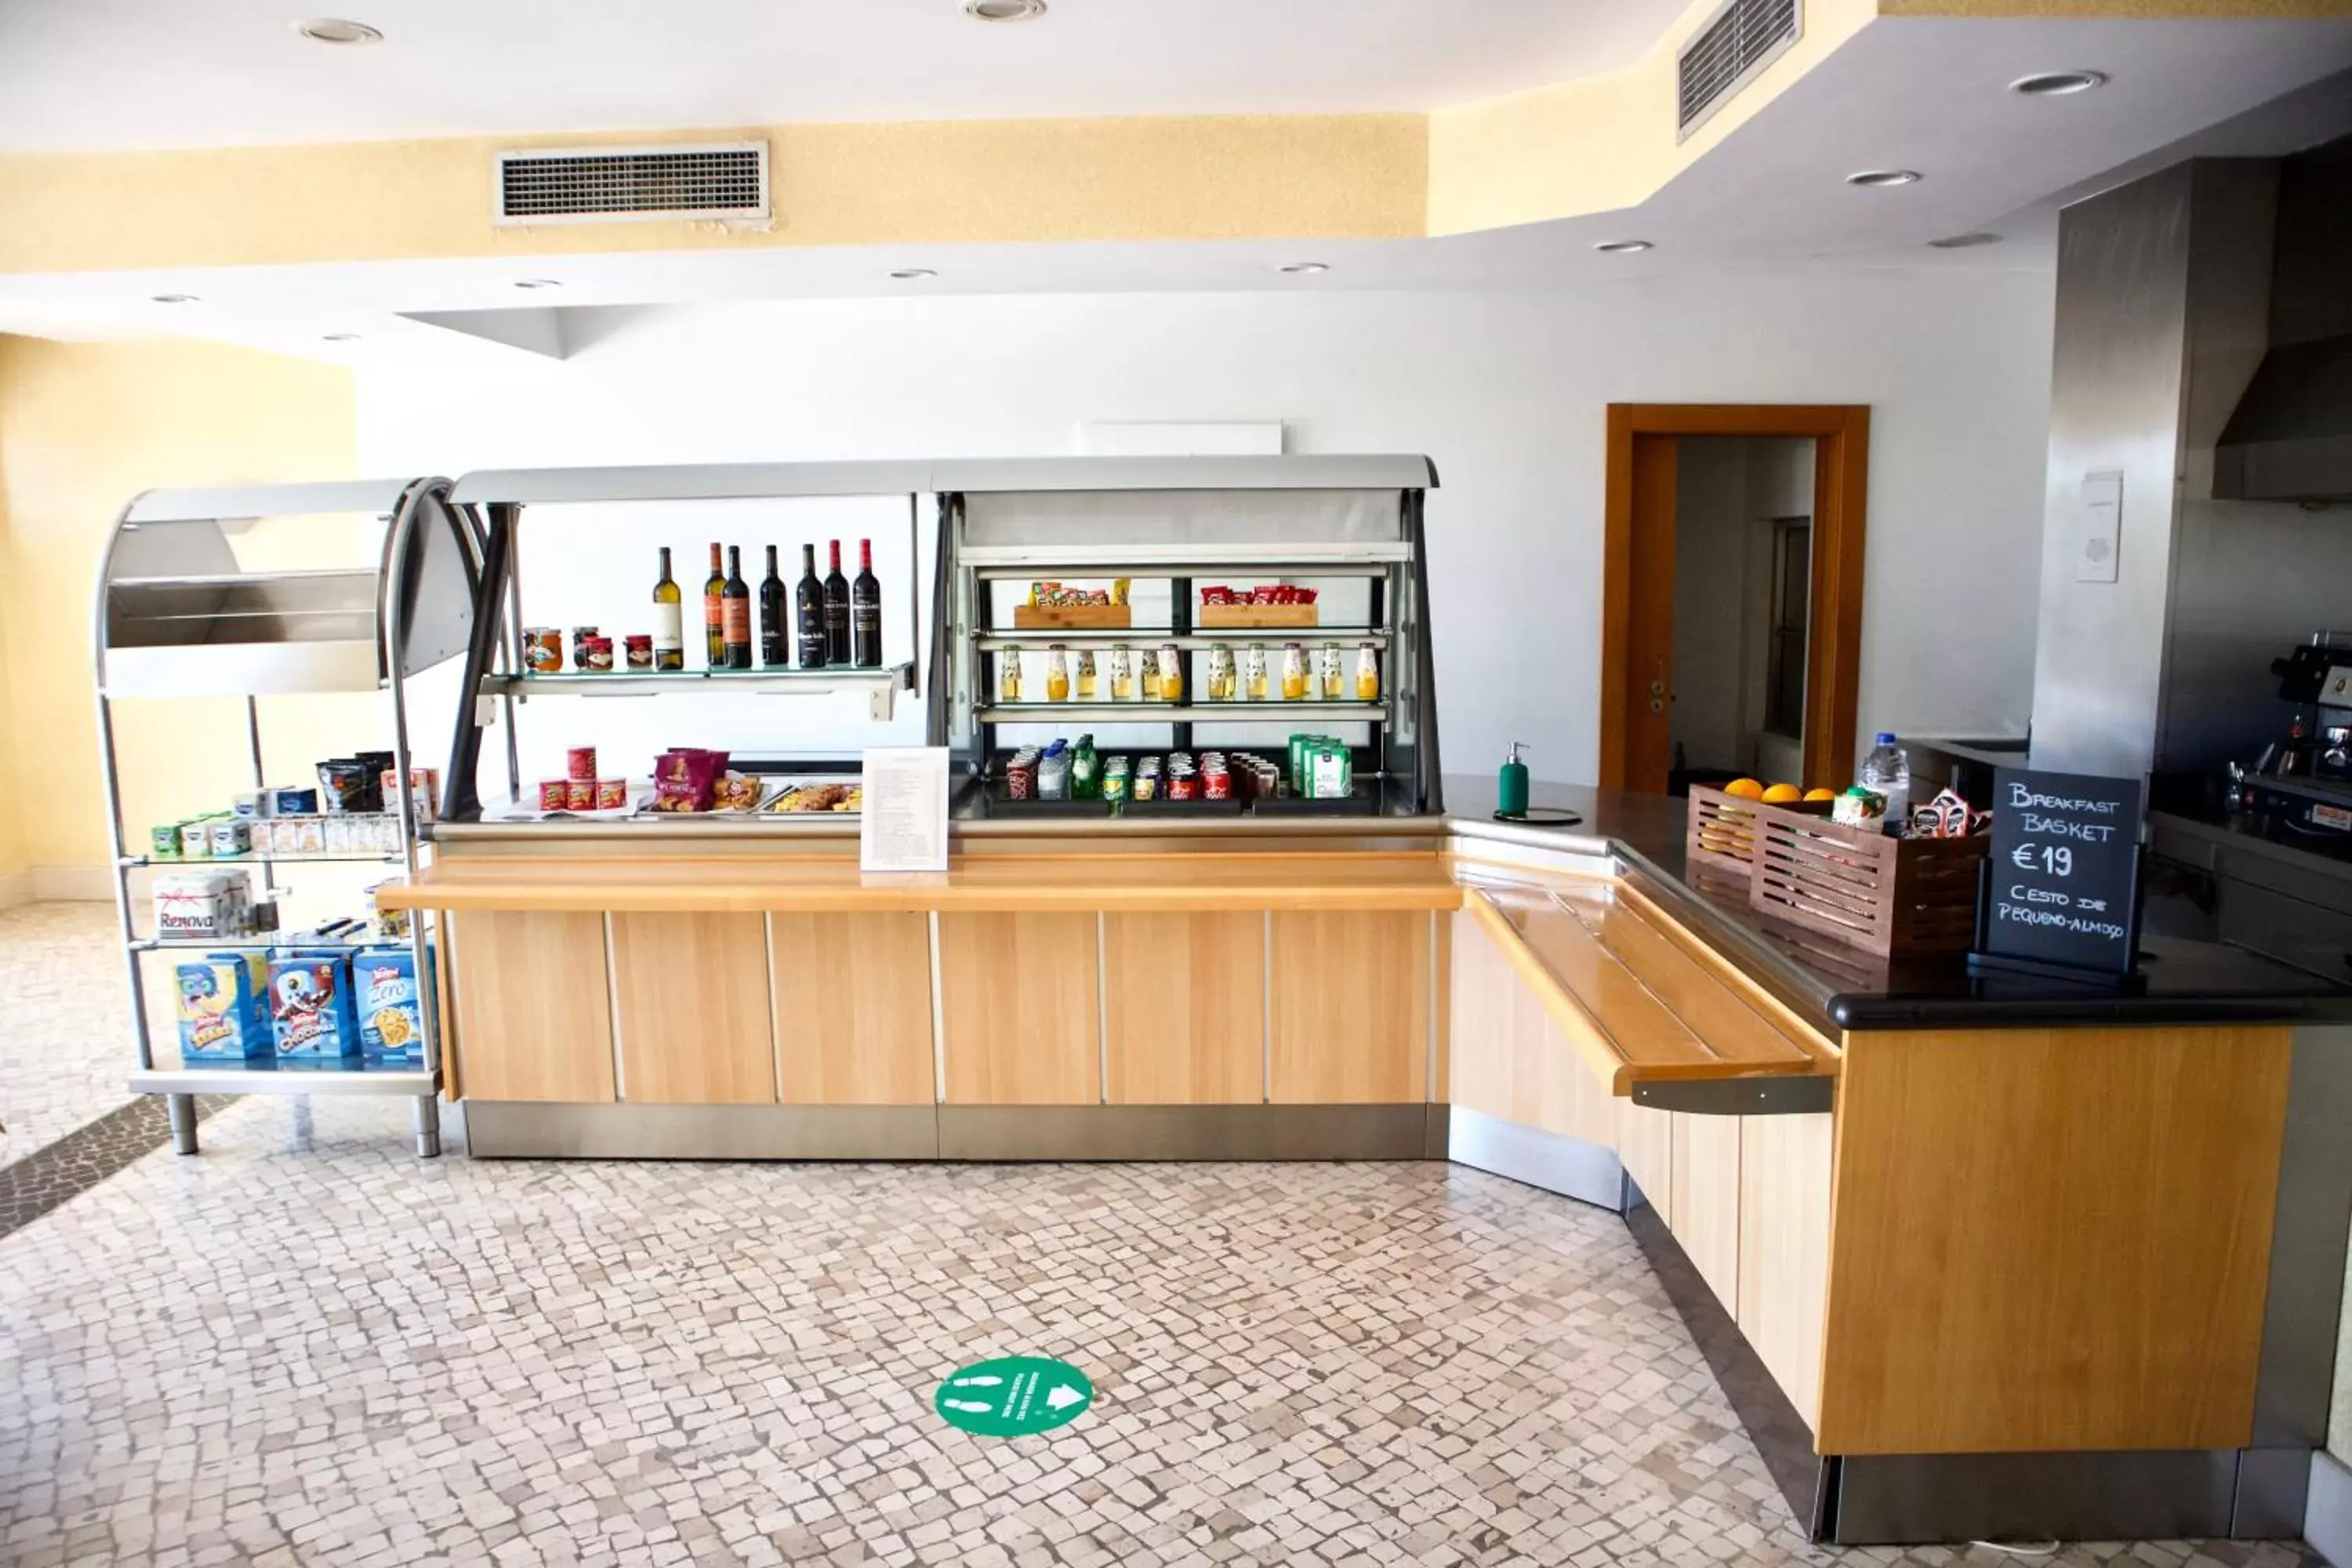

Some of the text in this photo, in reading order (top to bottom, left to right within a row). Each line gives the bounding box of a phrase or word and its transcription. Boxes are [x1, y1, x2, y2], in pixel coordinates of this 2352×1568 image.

[2008, 782, 2120, 814] BREAKFAST
[2020, 812, 2116, 842] BASKET
[2010, 884, 2107, 911] CESTO DE
[160, 913, 213, 927] Renova
[370, 983, 405, 1004] Zero
